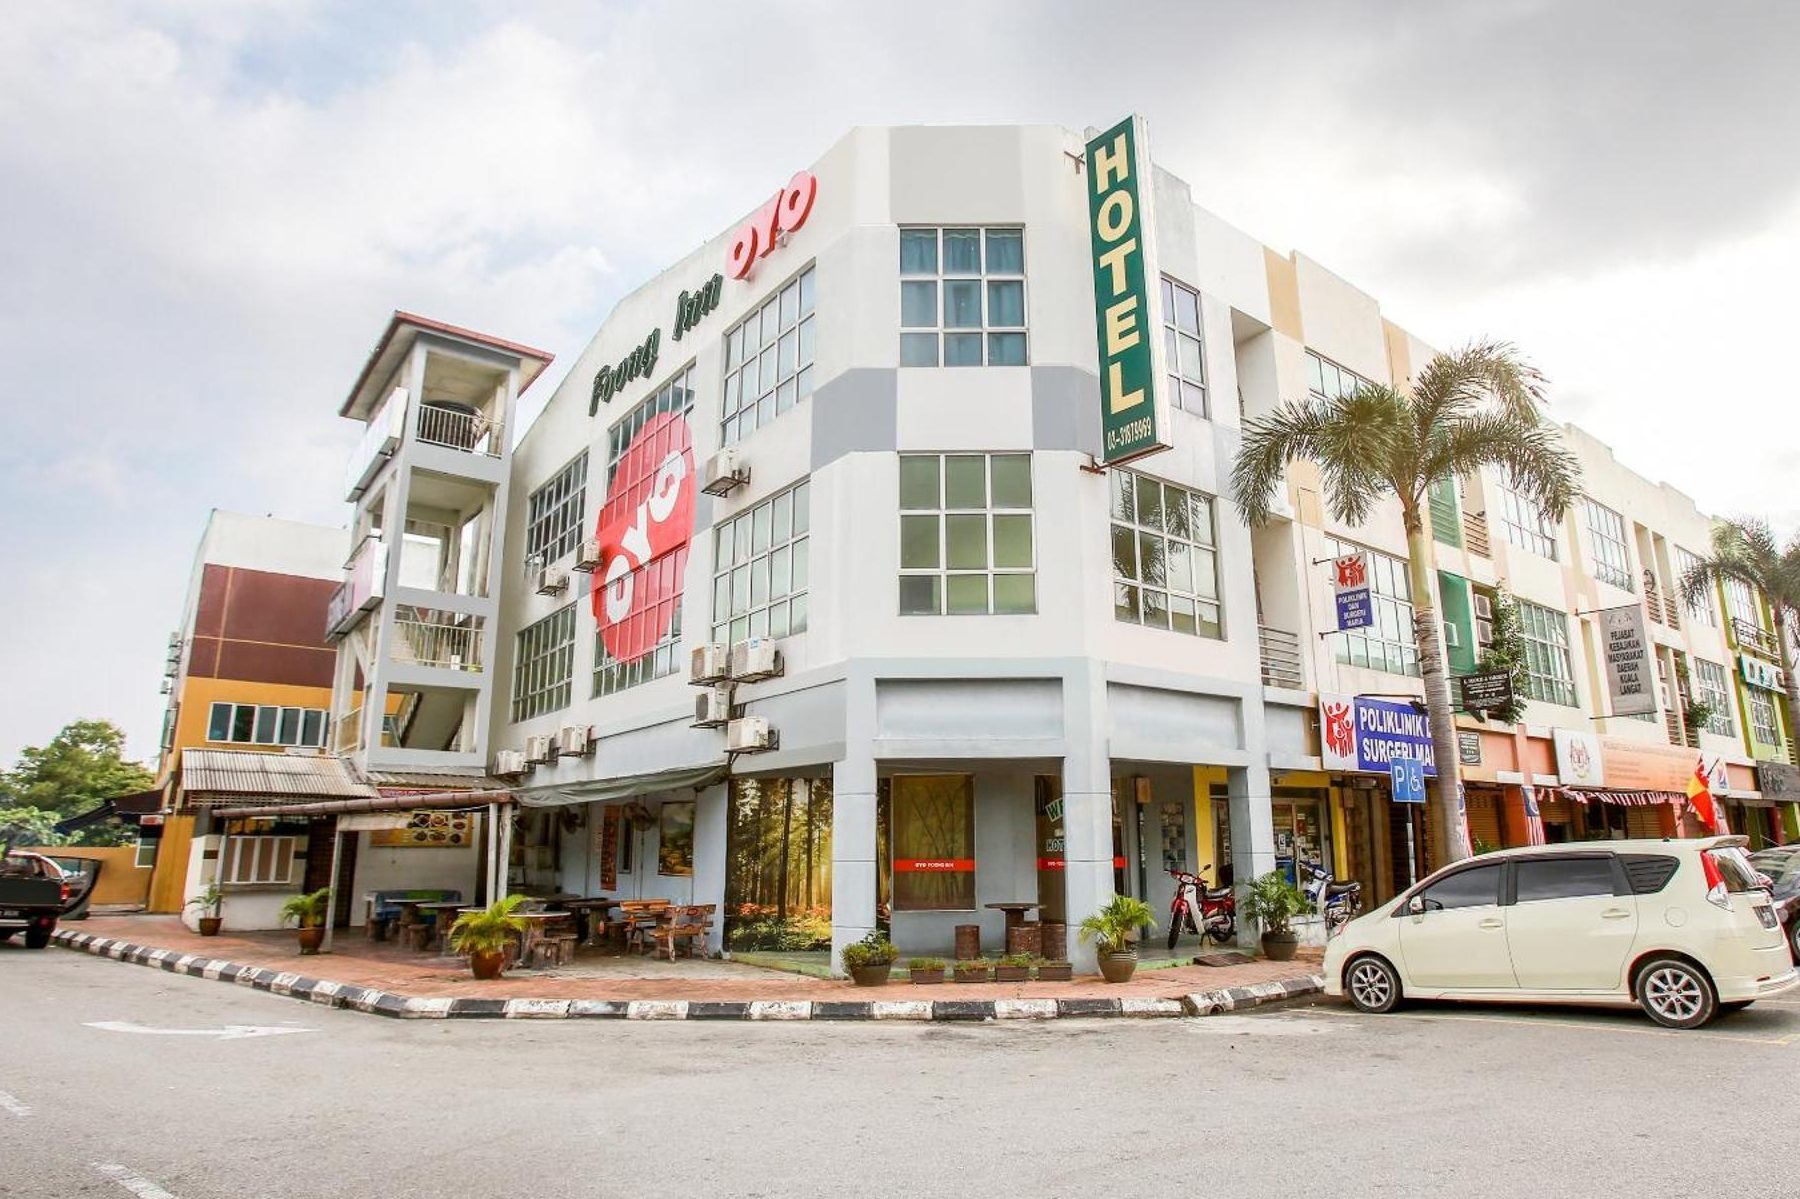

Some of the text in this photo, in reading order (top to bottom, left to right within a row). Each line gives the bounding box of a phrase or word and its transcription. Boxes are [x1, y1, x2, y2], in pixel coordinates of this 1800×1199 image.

[726, 171, 817, 280] OYO
[1094, 133, 1145, 415] HOTEL
[588, 272, 724, 417] Foong Inn
[604, 450, 686, 625] OYO
[1610, 629, 1635, 641] PEJABAT
[1360, 706, 1426, 738] POLIKLINIK
[1619, 683, 1642, 696] LANGAT
[1394, 765, 1405, 793] P
